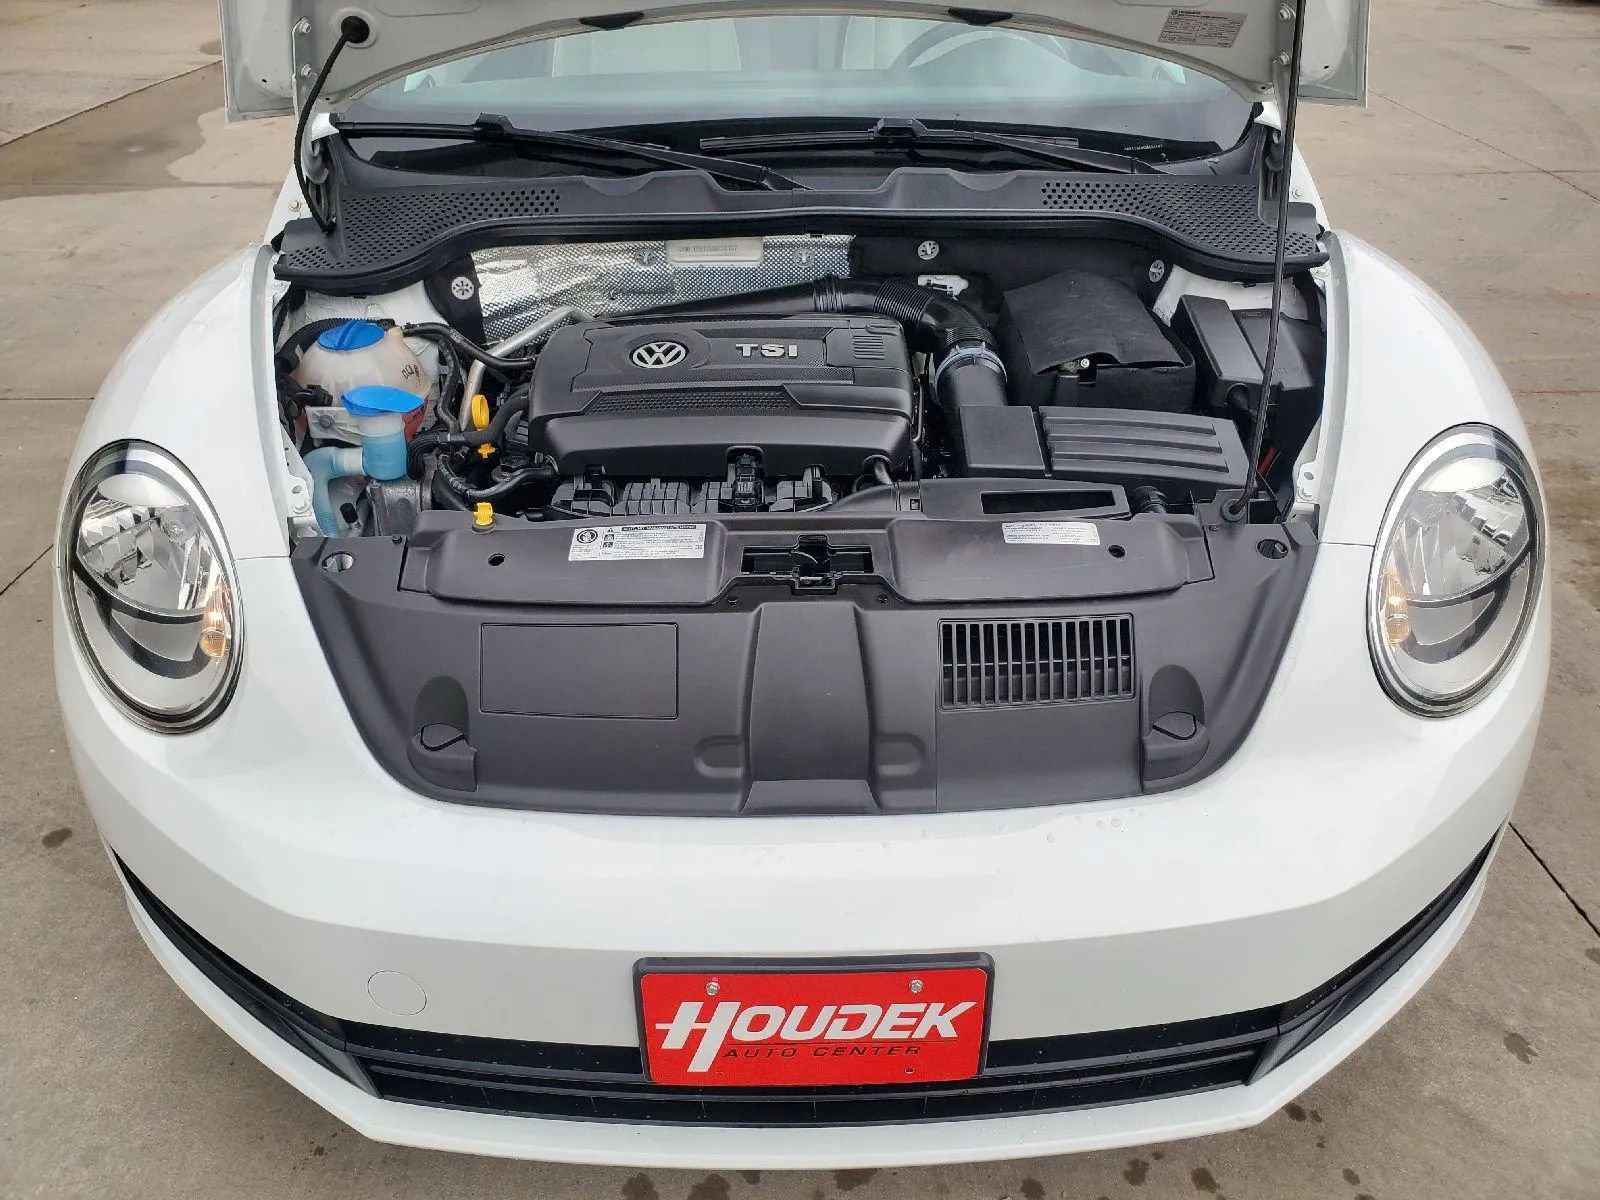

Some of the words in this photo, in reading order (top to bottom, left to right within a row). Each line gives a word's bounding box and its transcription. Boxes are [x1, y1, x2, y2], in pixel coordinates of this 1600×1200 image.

[632, 341, 687, 369] VW
[735, 343, 798, 357] TSI
[655, 1001, 977, 1073] HOUDEK
[722, 1046, 798, 1059] AUTO
[813, 1045, 921, 1057] CENTER
